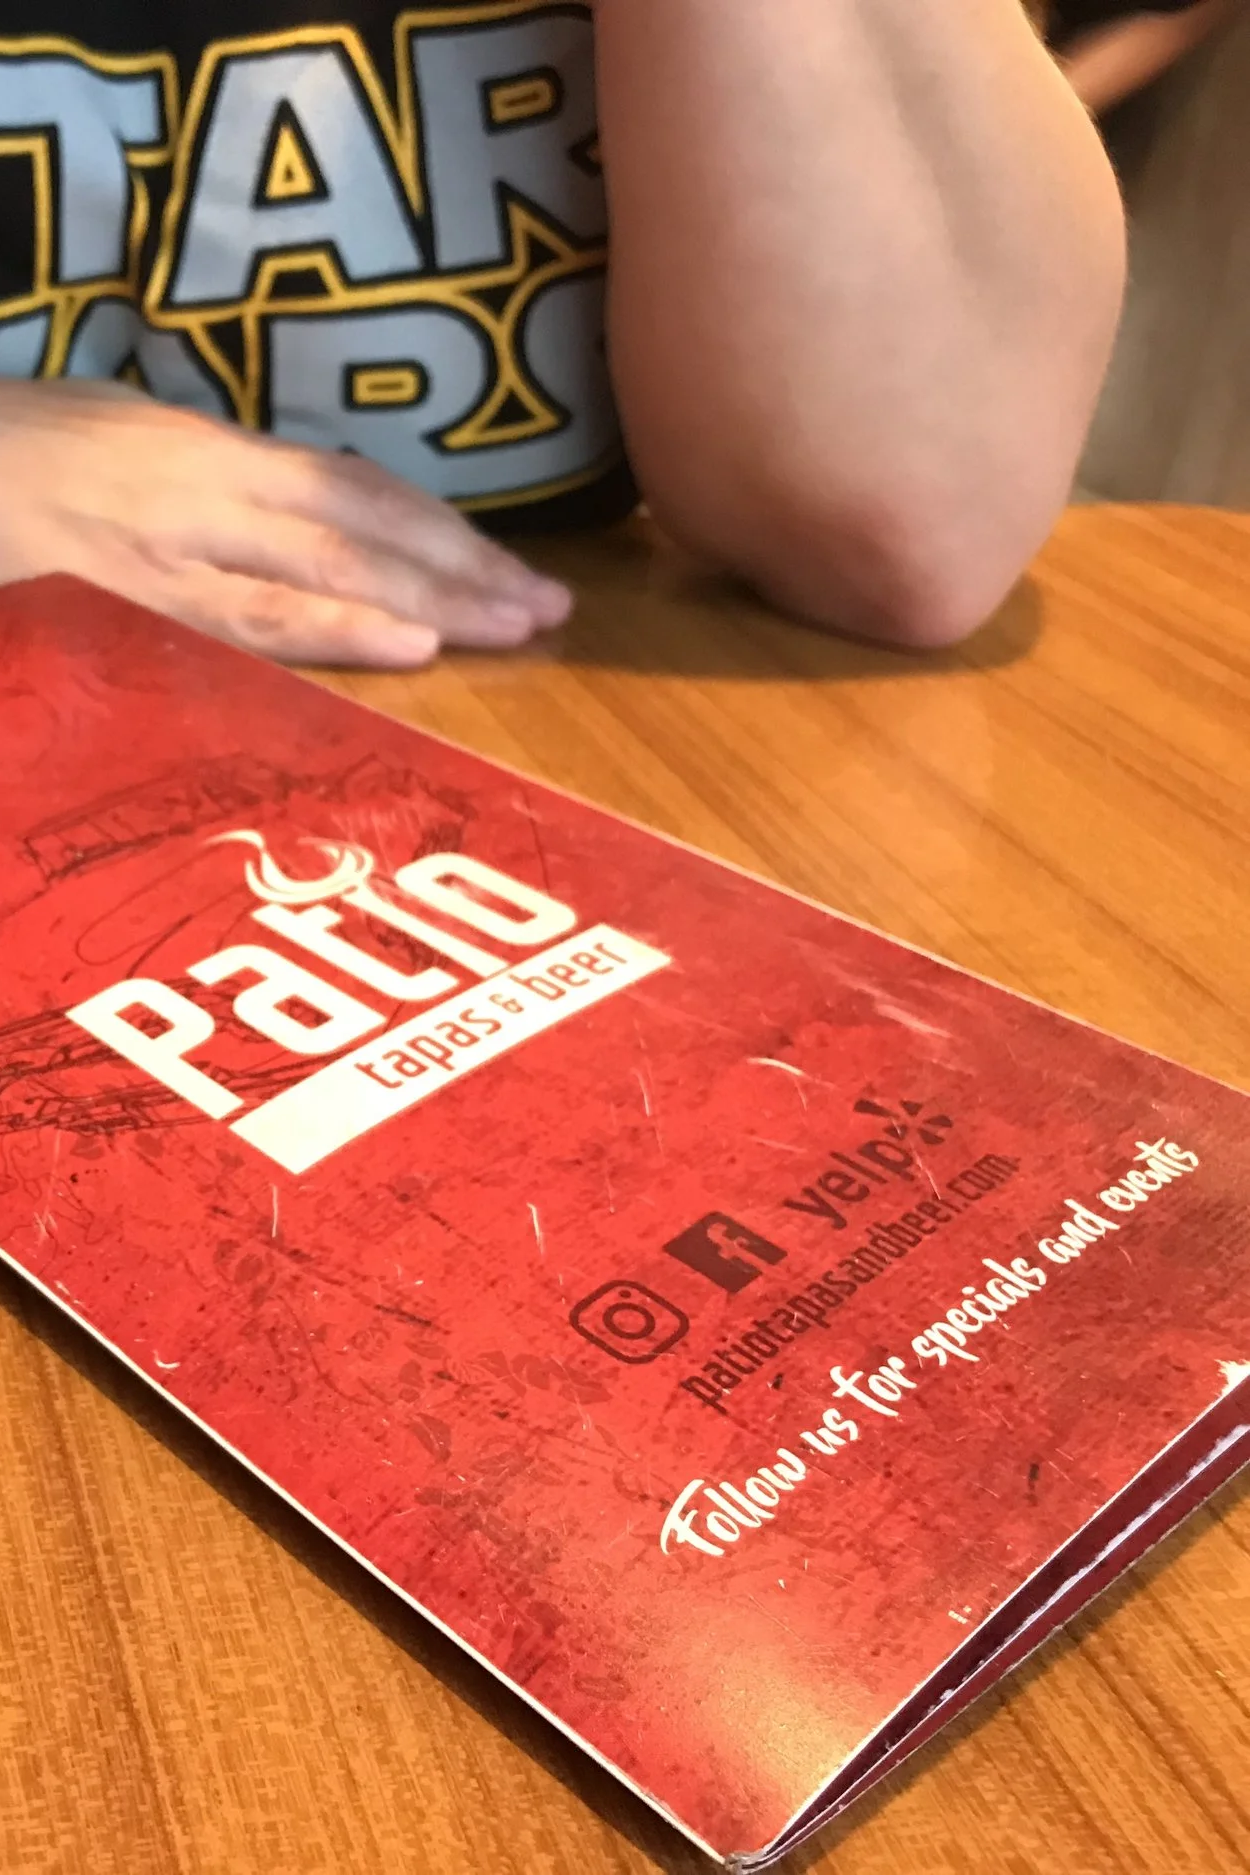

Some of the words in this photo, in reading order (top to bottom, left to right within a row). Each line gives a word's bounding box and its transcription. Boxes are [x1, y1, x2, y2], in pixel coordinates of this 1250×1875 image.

[66, 851, 578, 1120] Patio
[353, 1004, 502, 1089] tapas
[488, 991, 525, 1015] &
[508, 939, 629, 1002] beer
[679, 1152, 1021, 1415] patiotapasandbeer.com
[784, 1139, 916, 1231] yelp
[659, 1447, 808, 1556] Follow
[800, 1407, 859, 1456] us
[830, 1364, 918, 1417] for
[912, 1257, 1047, 1363] specials
[1038, 1198, 1121, 1265] and
[1099, 1136, 1199, 1212] events
